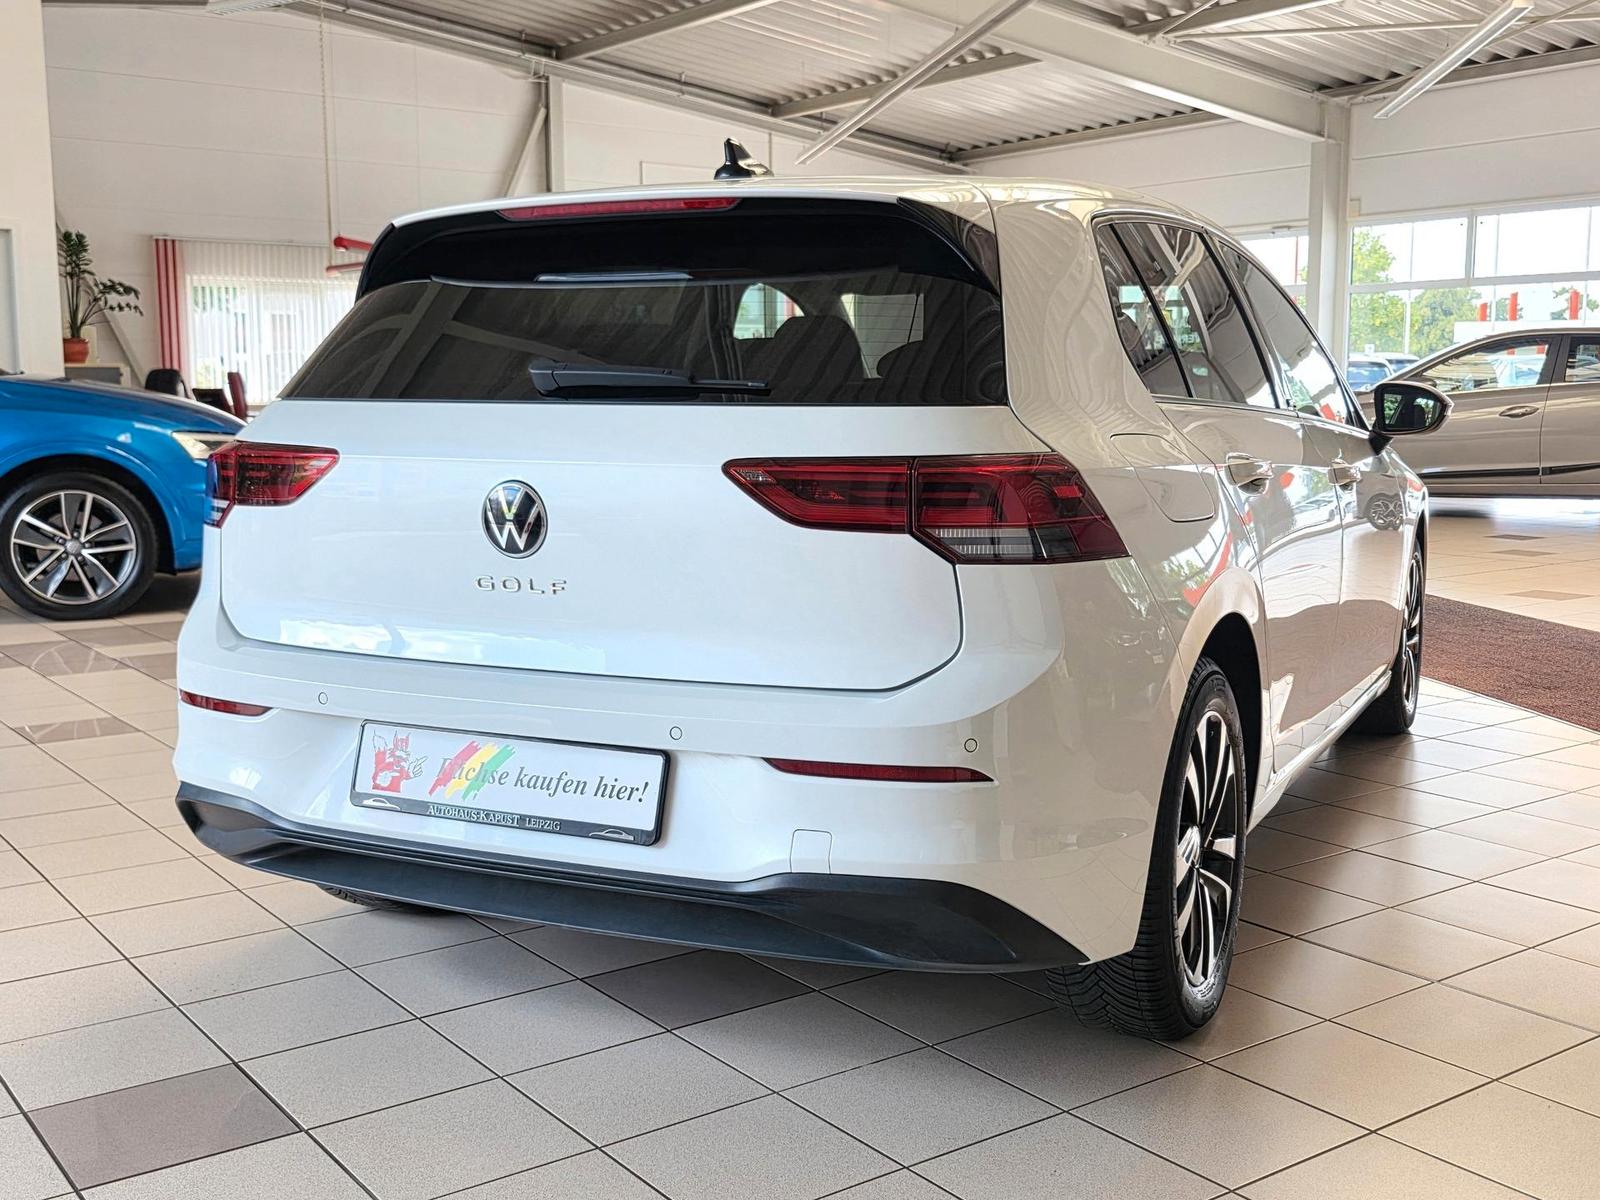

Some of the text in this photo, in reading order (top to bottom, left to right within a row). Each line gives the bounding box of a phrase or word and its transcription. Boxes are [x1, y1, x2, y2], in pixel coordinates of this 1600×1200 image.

[483, 482, 544, 555] VW
[474, 575, 567, 595] GOLF
[514, 766, 588, 798] kaufen
[593, 775, 649, 803] hier!
[525, 817, 562, 831] LEIPZIG
